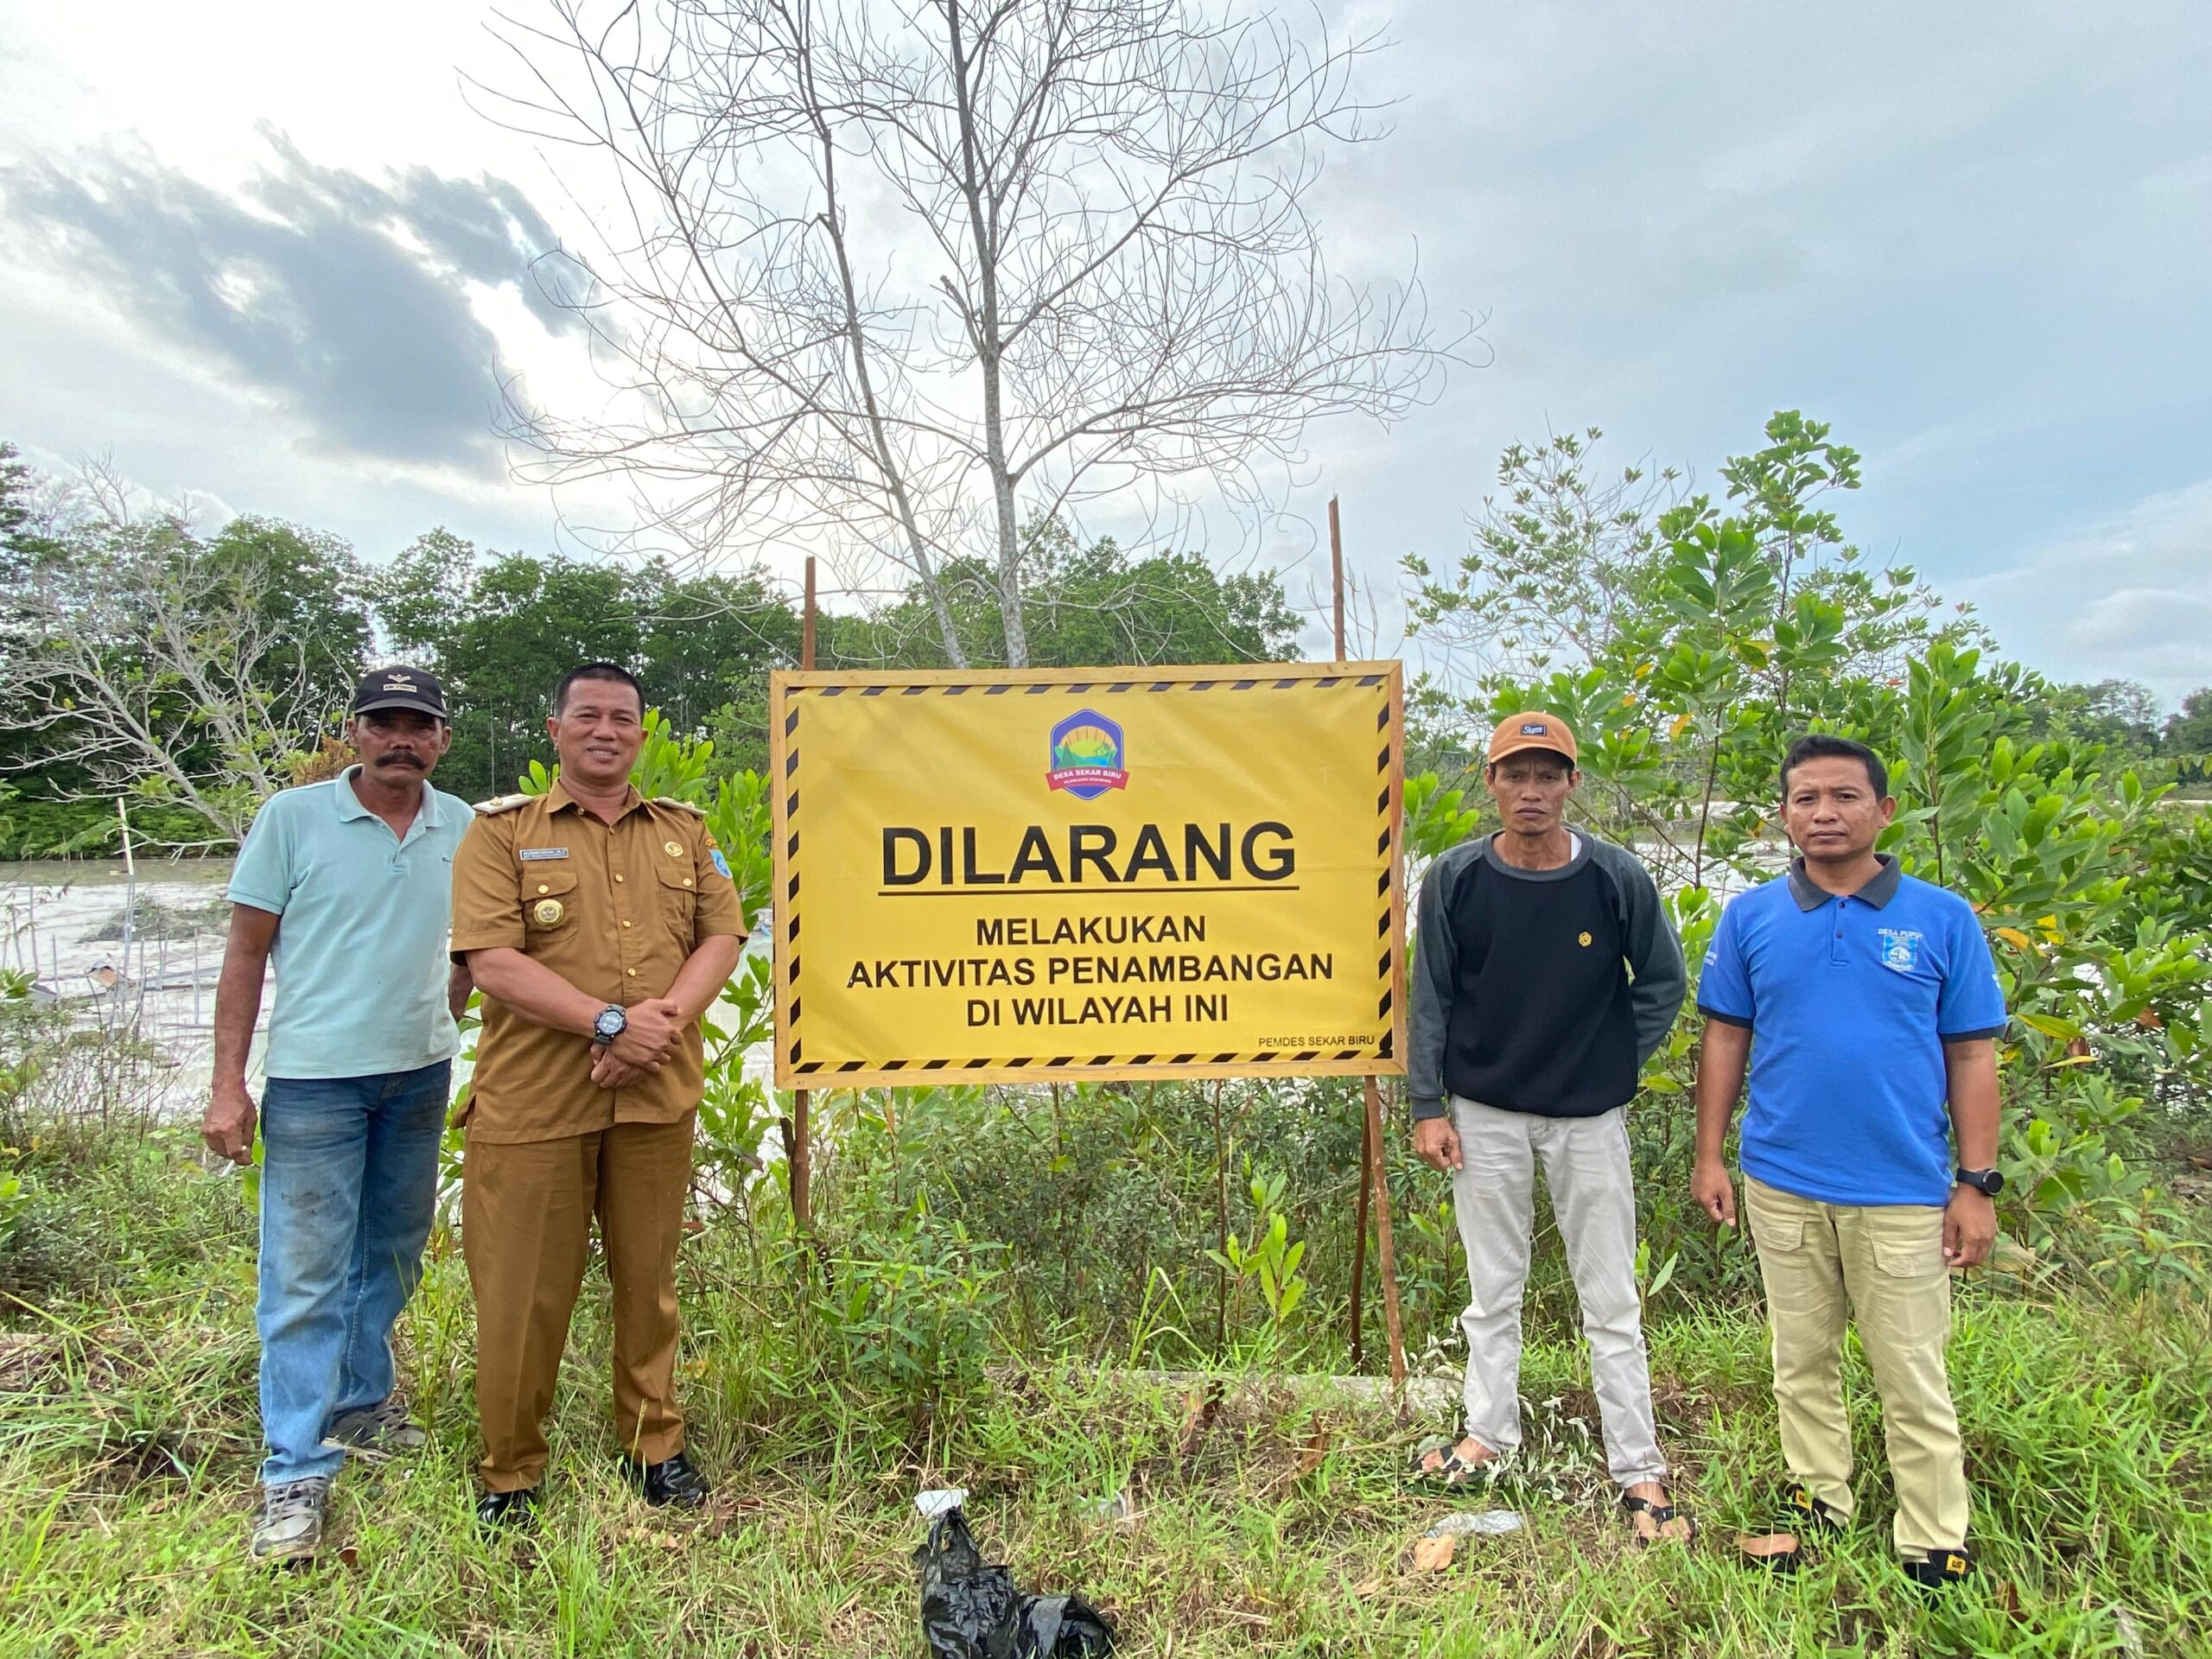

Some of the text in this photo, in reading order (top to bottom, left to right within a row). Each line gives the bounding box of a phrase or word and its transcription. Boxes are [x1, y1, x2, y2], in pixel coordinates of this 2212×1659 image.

[1052, 771, 1074, 780] DESA
[1103, 770, 1122, 779] BIRU
[881, 820, 1296, 886] DILARANG
[976, 915, 1205, 946] MELAKUKAN
[846, 953, 1333, 988] AKTIVITAS PENAMBANGAN
[967, 994, 1228, 1027] DI WILAYAH INI
[1258, 1035, 1375, 1047] PEMDES SEKAR BIRU
